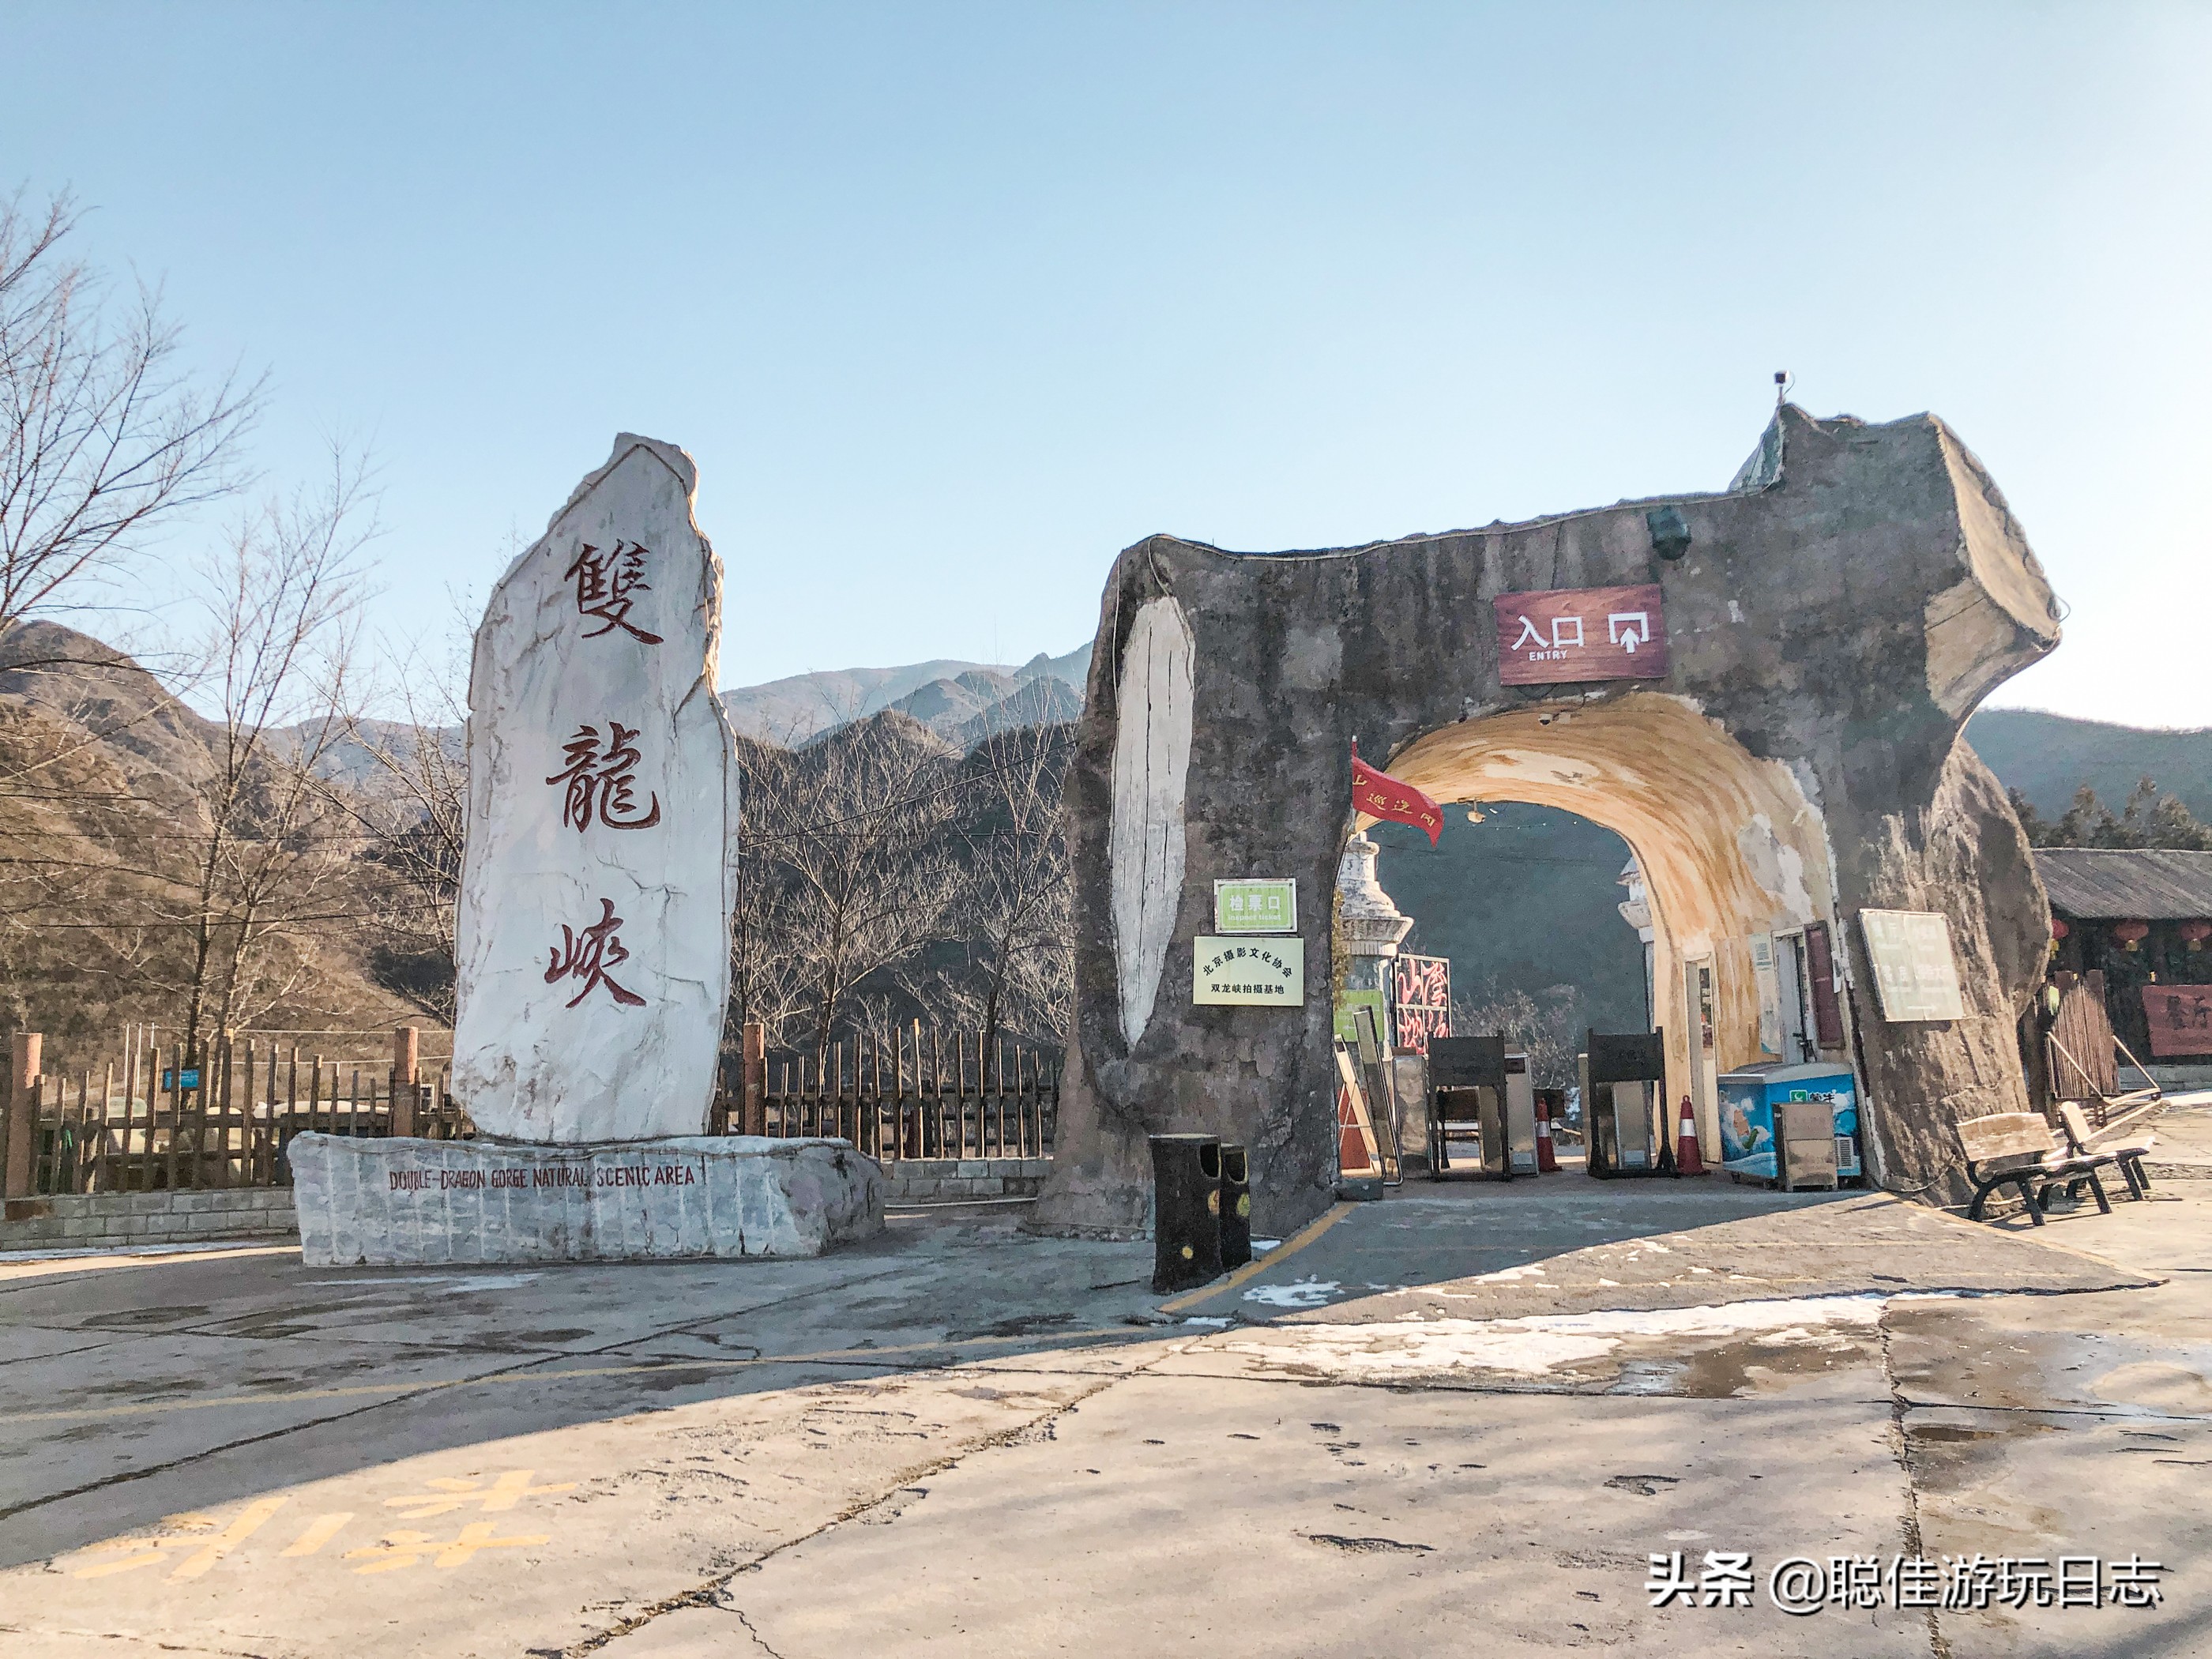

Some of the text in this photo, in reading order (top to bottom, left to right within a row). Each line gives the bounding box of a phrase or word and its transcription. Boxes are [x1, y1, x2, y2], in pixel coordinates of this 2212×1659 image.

[1510, 615, 1584, 651] 入口
[1529, 649, 1567, 661] ENTRY
[1202, 947, 1292, 978] 北京摄影文化协会
[1211, 984, 1285, 994] 双龙峡拍摄基地
[491, 1168, 529, 1189] GORGE
[532, 1167, 588, 1188] NATURAL
[596, 1165, 651, 1187] SCENIC
[654, 1165, 696, 1186] AREA
